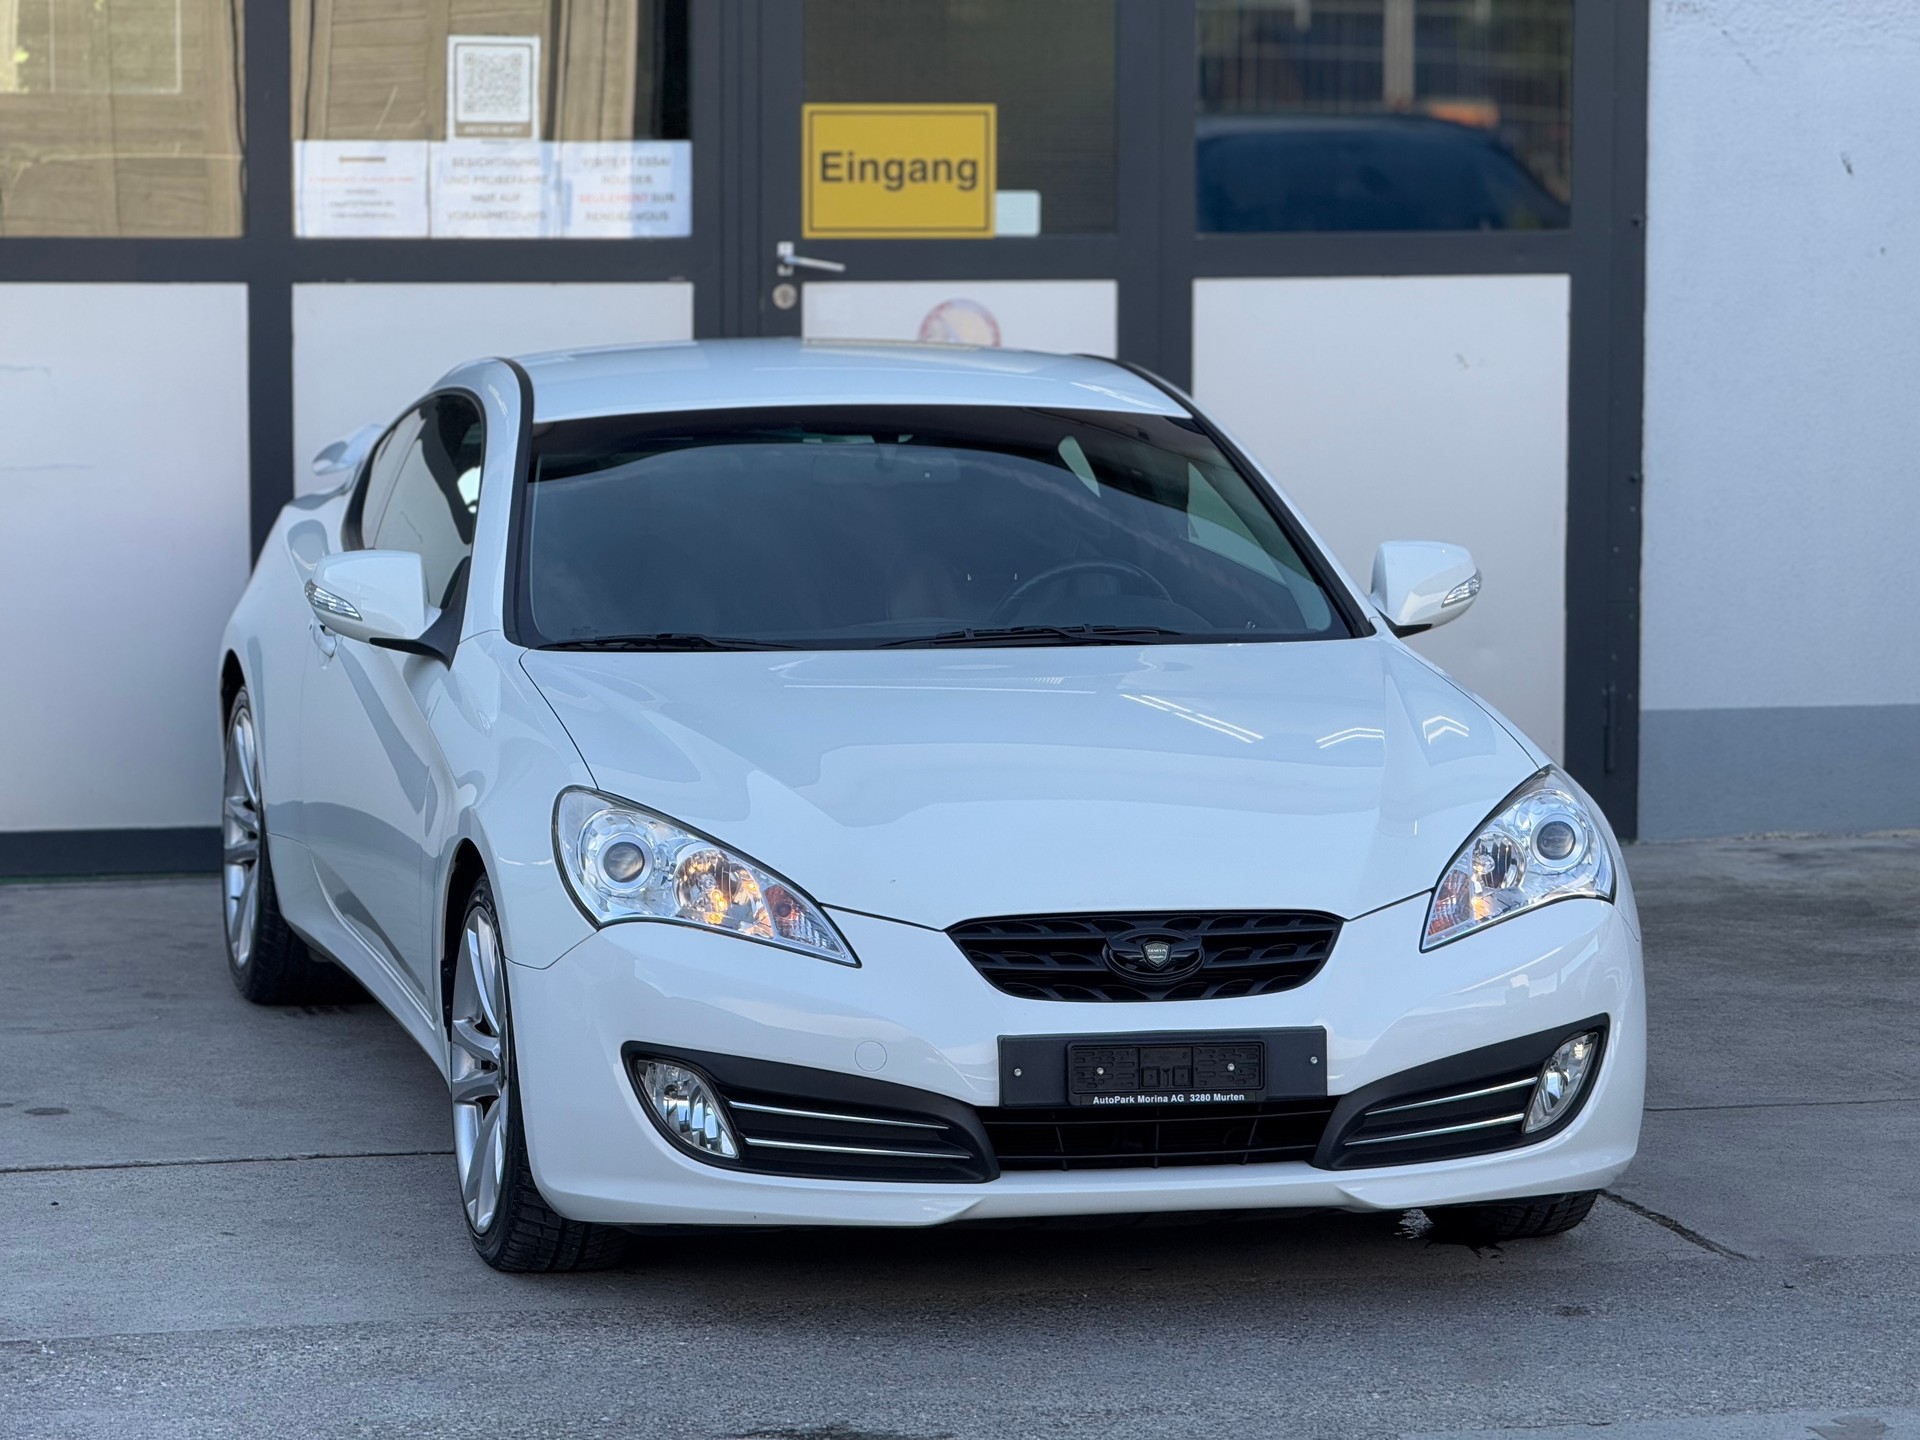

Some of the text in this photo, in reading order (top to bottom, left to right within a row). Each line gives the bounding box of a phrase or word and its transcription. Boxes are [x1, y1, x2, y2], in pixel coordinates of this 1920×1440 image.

[820, 151, 978, 191] Eingang
[1093, 1093, 1245, 1105] AutoPark Morina AG 3280 Murten
